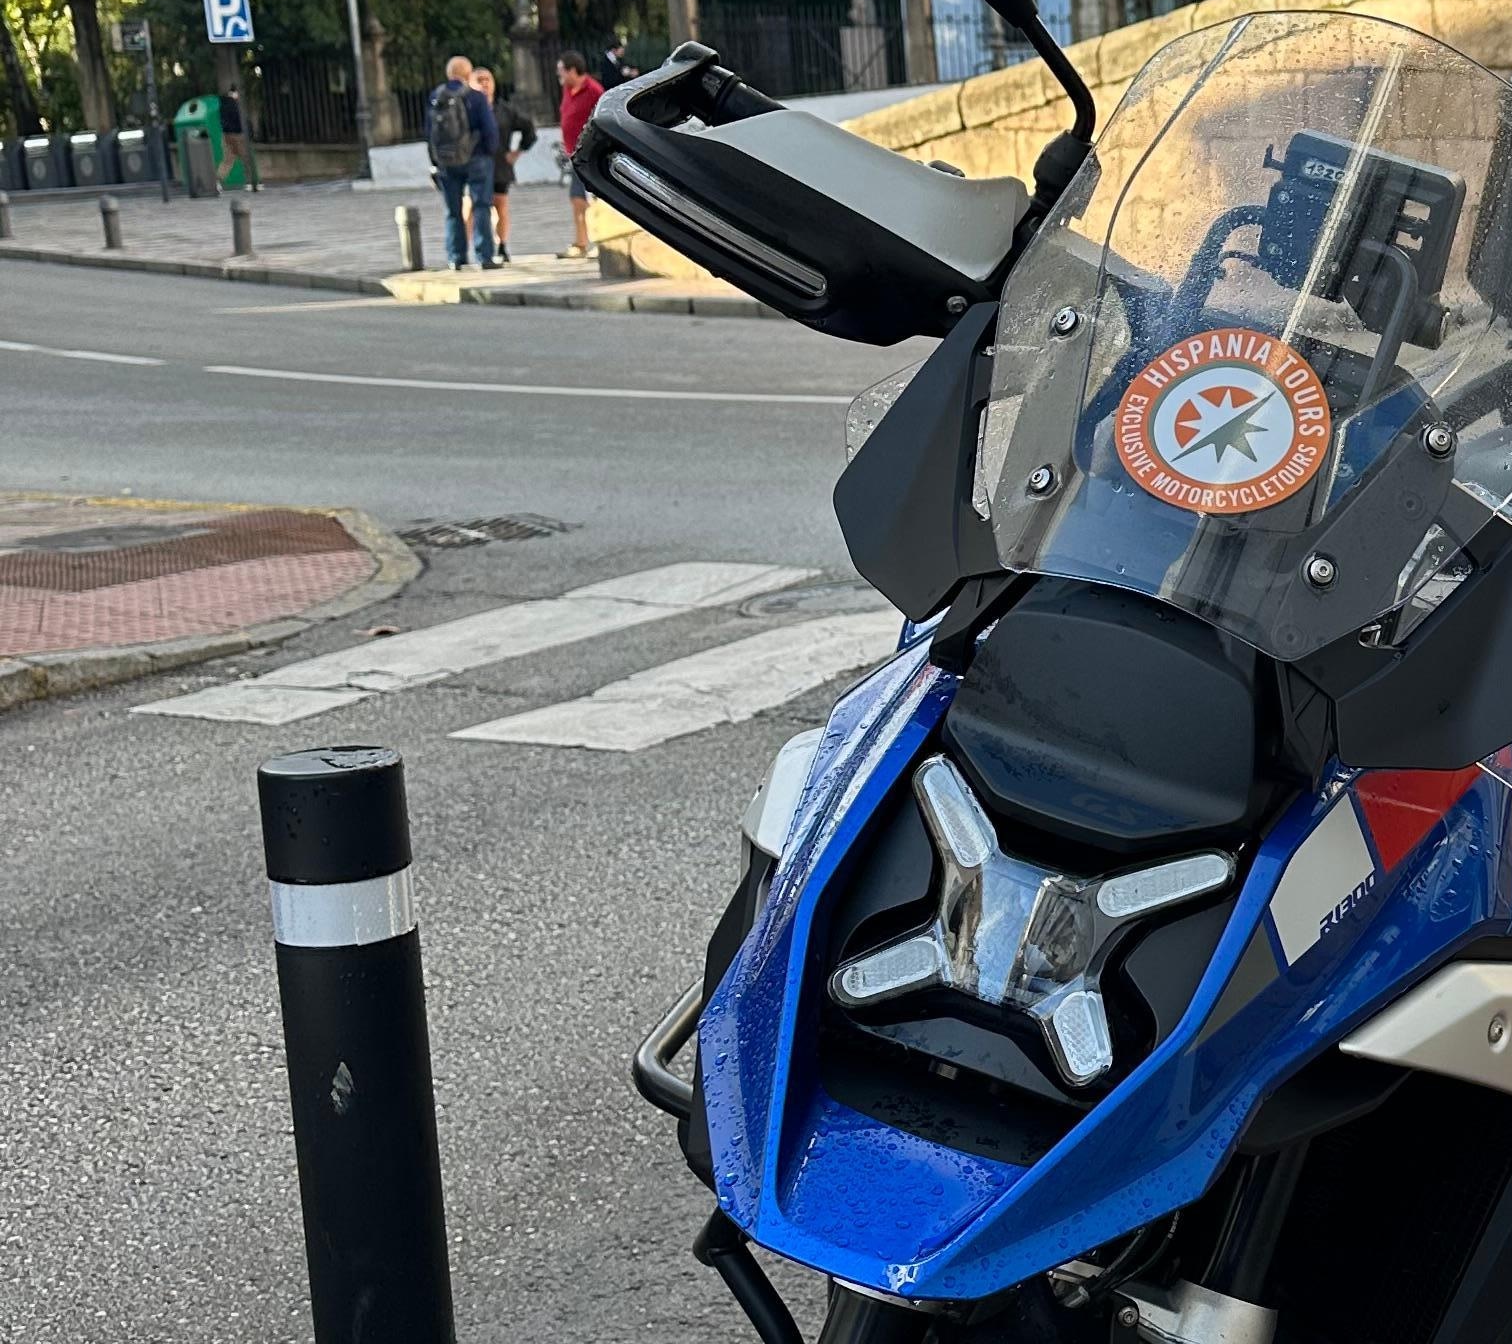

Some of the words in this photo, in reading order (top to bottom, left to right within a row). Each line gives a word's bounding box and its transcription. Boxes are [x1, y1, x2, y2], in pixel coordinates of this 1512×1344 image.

[1143, 333, 1274, 389] HISPANIA
[1274, 354, 1326, 438] TOURS
[1120, 393, 1157, 479] EXCLUSIVE
